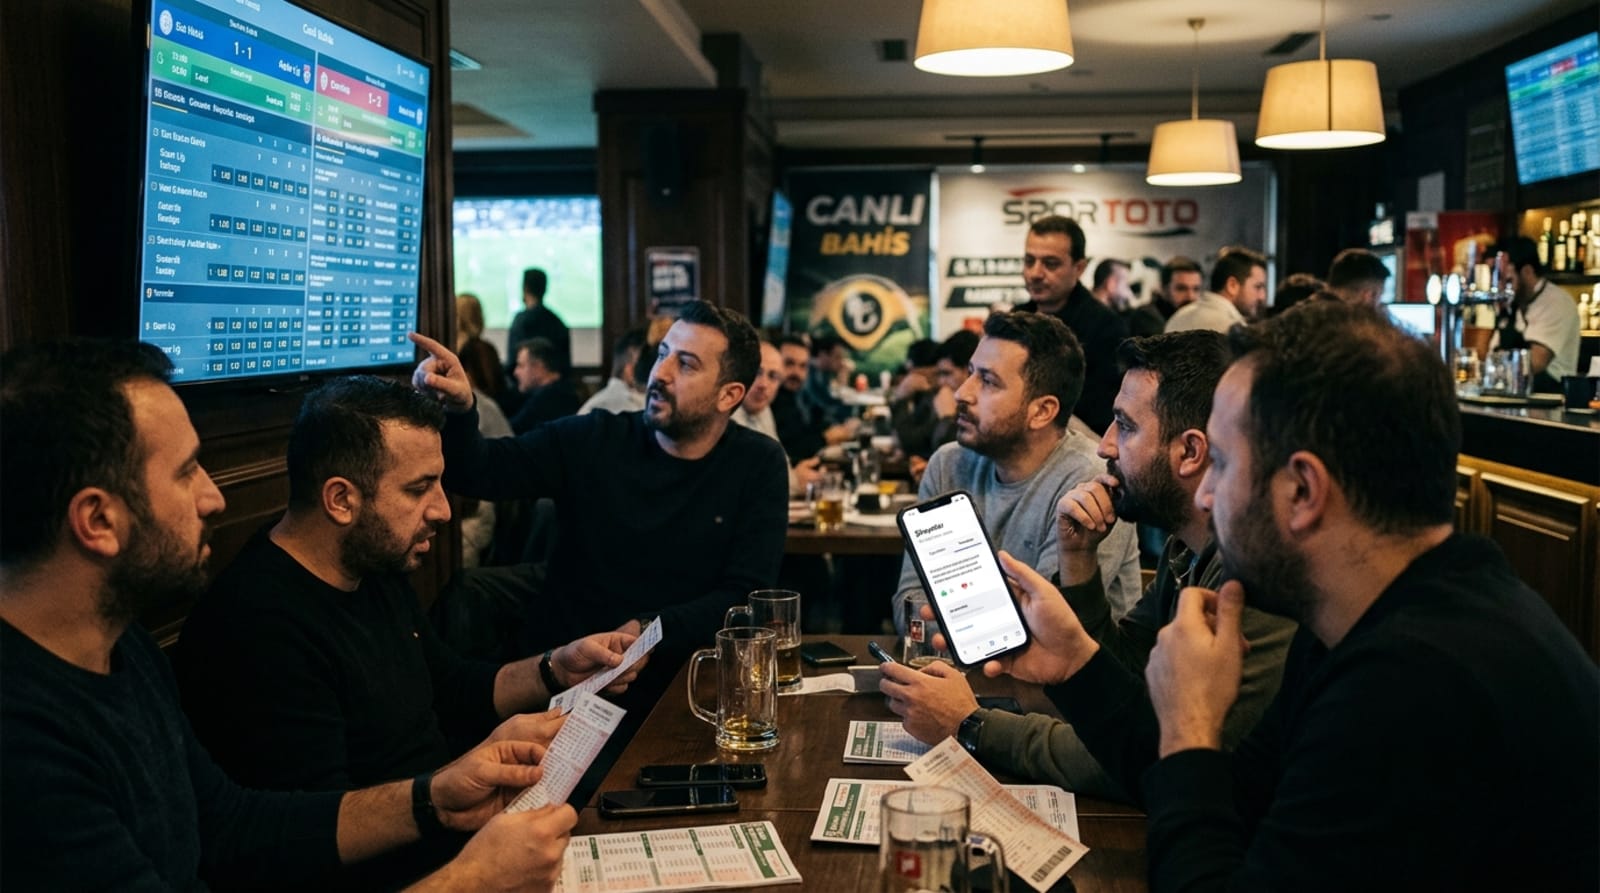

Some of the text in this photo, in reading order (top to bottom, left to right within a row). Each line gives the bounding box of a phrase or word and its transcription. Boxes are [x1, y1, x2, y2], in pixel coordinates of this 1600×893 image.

[806, 194, 926, 225] CANLI
[1103, 199, 1199, 225] TOTO
[820, 225, 911, 256] BAHİS
